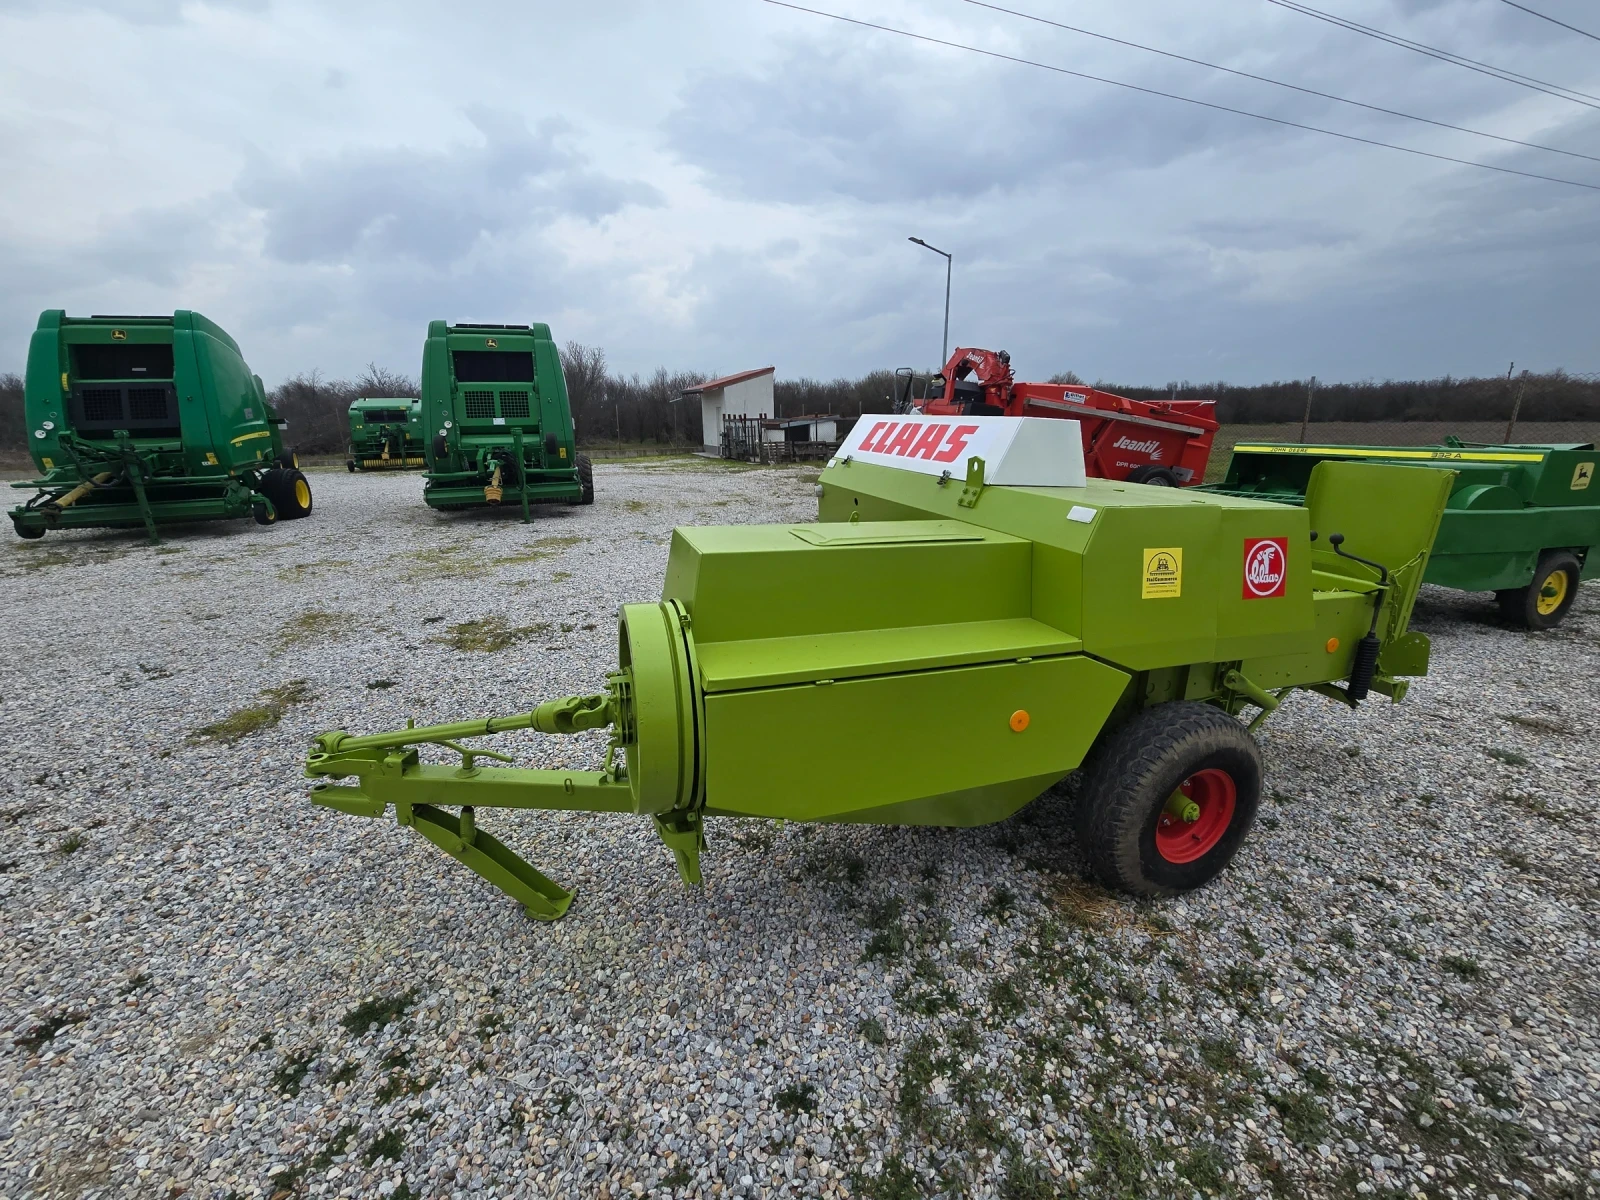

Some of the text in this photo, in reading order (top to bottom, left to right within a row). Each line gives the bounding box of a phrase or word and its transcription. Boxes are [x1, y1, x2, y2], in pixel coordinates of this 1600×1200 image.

[966, 351, 985, 365] Jeantil
[858, 421, 980, 463] CLAAS
[1113, 435, 1160, 453] Jeantil
